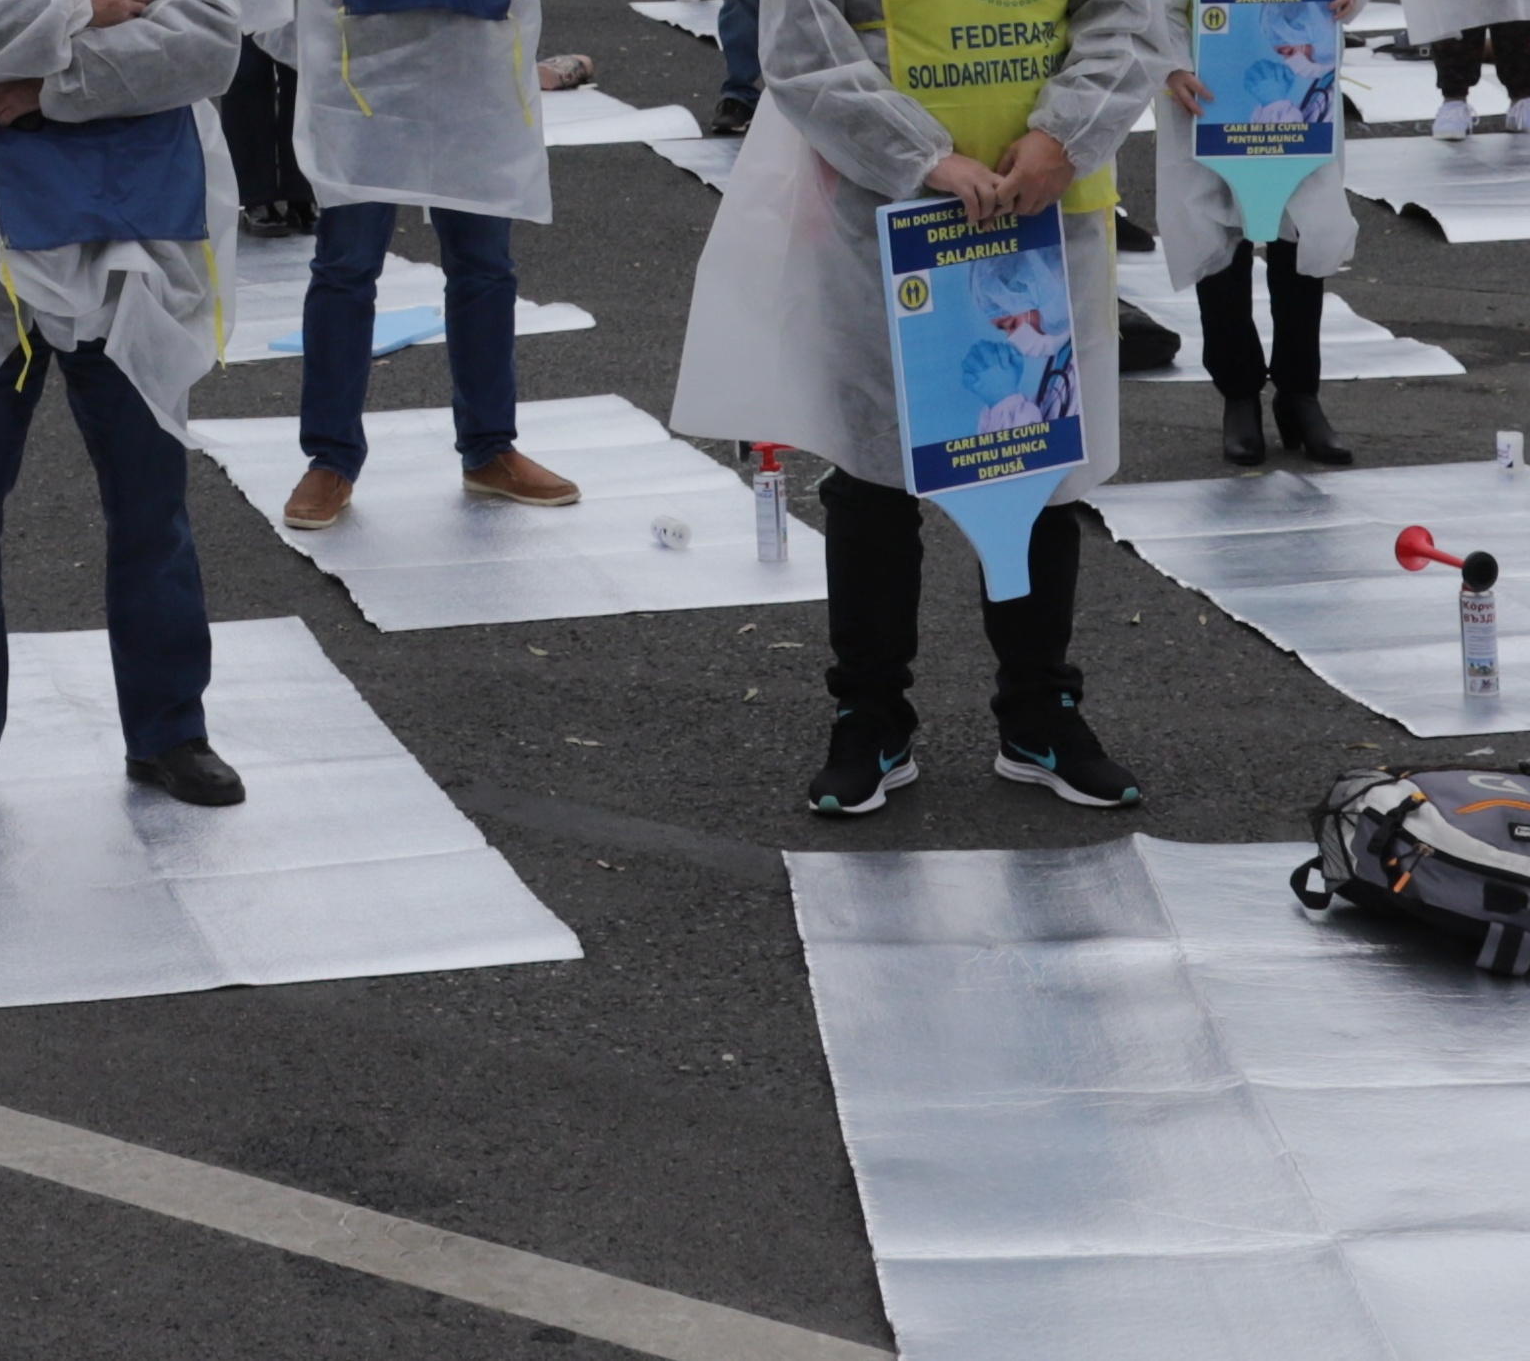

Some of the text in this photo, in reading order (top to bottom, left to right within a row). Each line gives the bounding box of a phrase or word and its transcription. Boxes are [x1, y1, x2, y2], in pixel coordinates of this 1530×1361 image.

[907, 56, 1040, 90] SOLIDARITATEA
[1223, 123, 1309, 133] CARE MI SE CUVIN
[1227, 134, 1304, 144] PENTRU MUNCA
[1246, 145, 1284, 155] DEPUSĂ
[892, 216, 911, 230] ÎMI
[913, 208, 956, 227] DORESC
[927, 214, 1019, 244] DREPTILE
[936, 238, 1019, 267] SALARIALE
[945, 421, 1051, 454] CARE MI SE CUVIN
[951, 439, 1048, 469] PENTRU MUNCA
[978, 457, 1026, 480] DEPUSĂ
